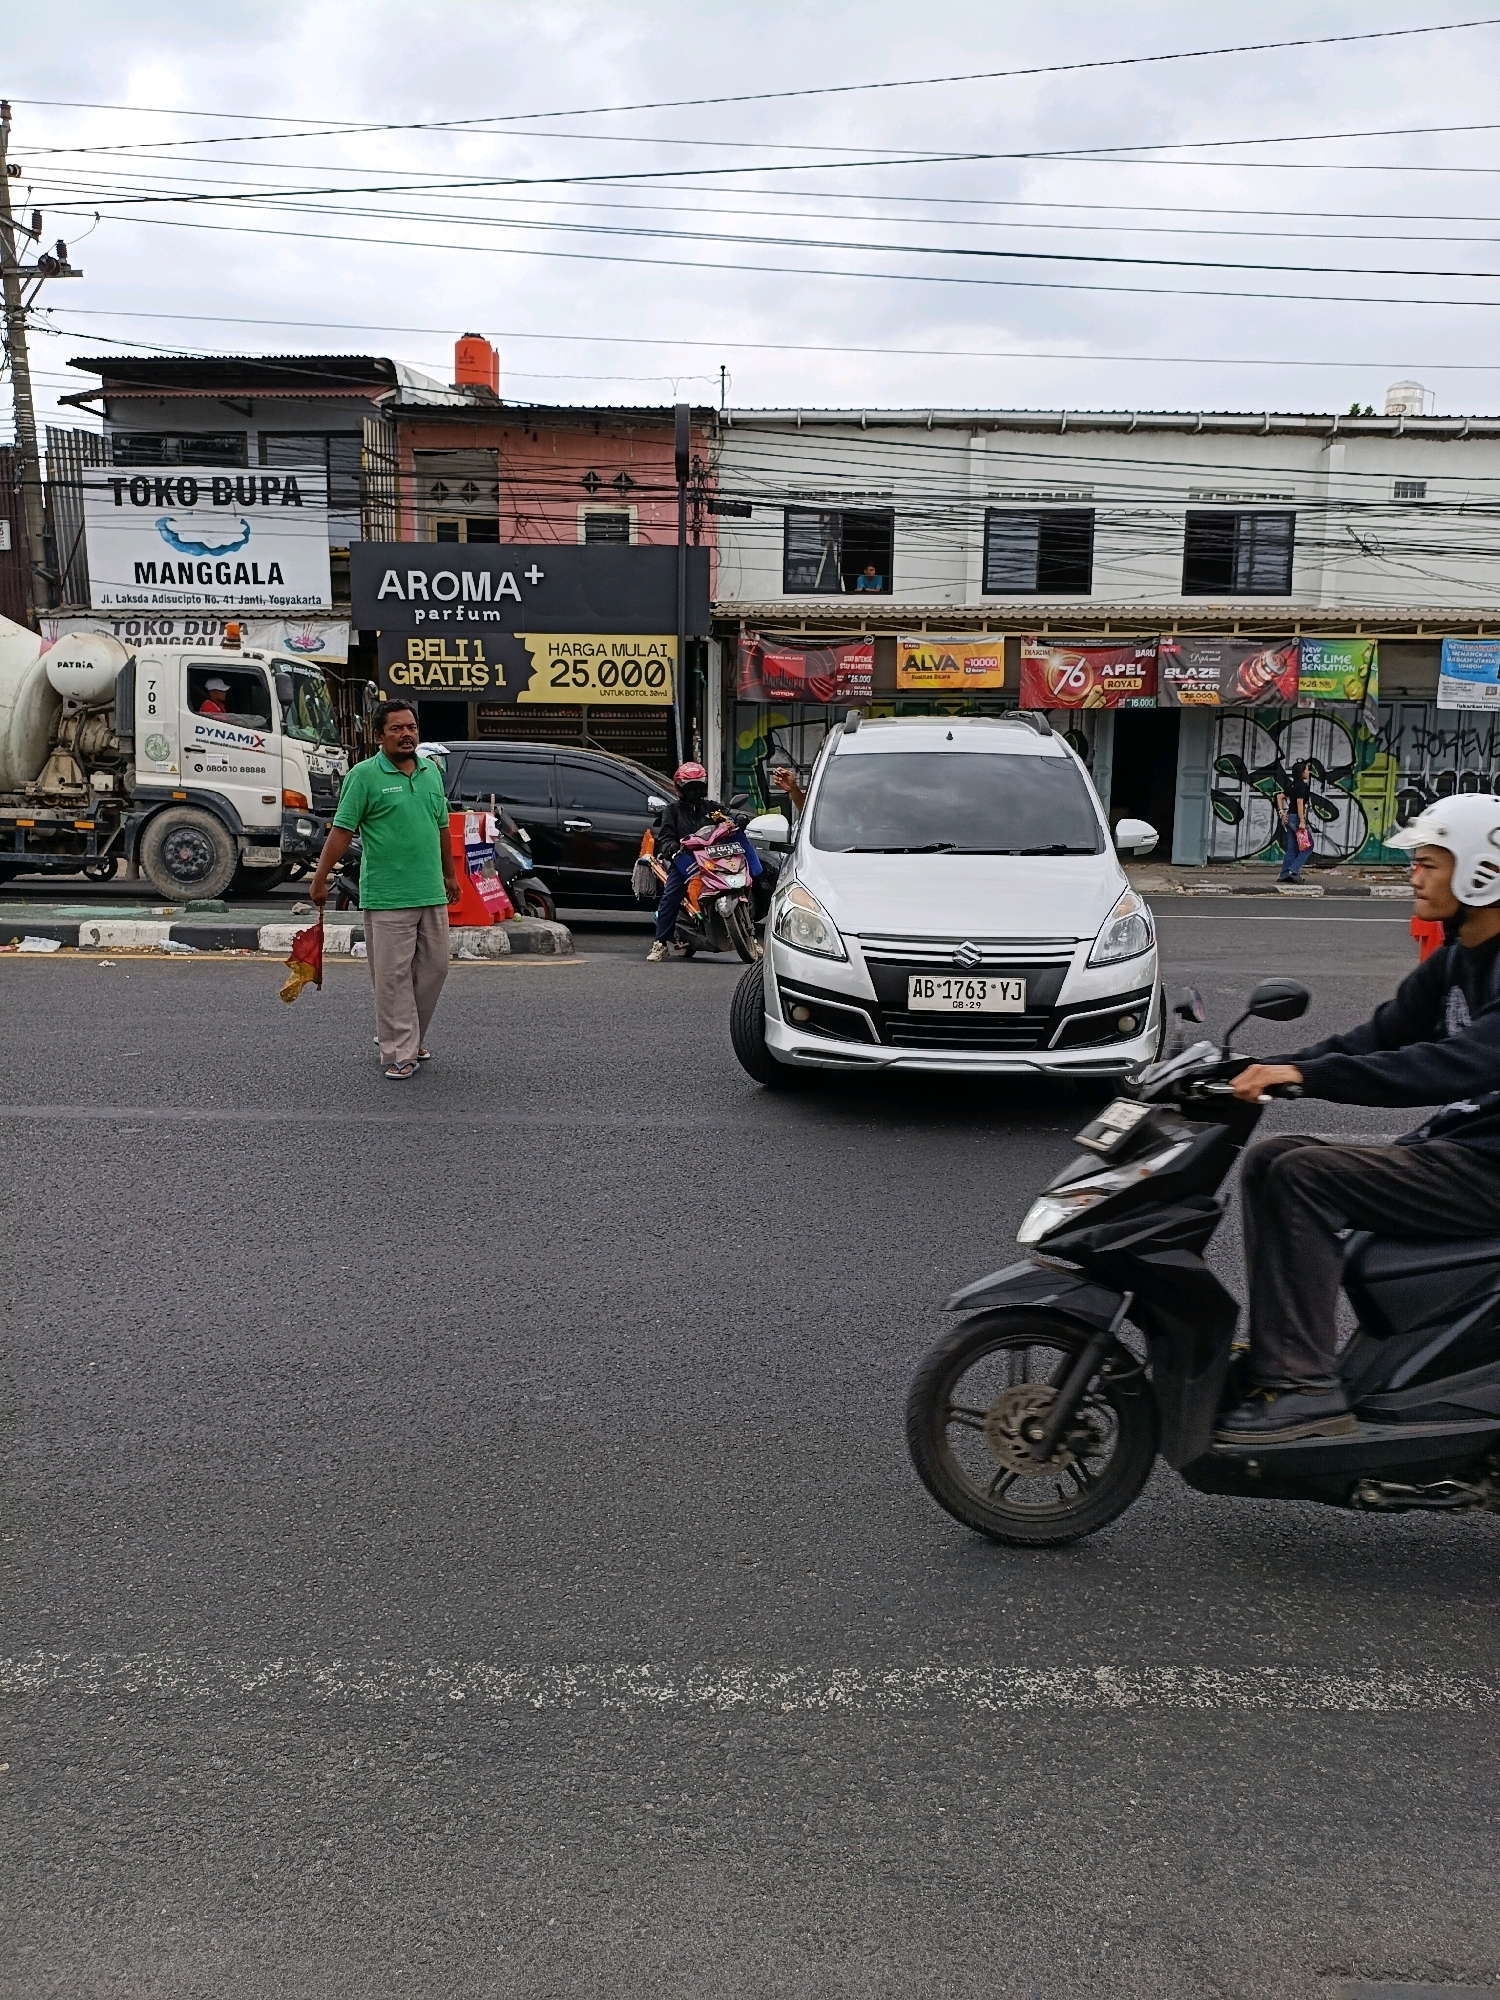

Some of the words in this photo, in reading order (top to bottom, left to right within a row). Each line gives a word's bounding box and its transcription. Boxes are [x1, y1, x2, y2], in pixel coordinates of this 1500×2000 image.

[107, 476, 198, 507] TOKO
[212, 475, 303, 507] DUPA
[134, 561, 285, 585] MANGGALA
[101, 594, 113, 605] Jl.
[116, 594, 149, 605] Laksda
[151, 594, 202, 606] Adisucipto
[204, 594, 220, 605] No.
[222, 594, 235, 605] 41
[268, 594, 322, 607] Yogyakarta
[414, 605, 501, 625] parfum
[110, 620, 174, 637] TOKO
[407, 638, 469, 662] BELI
[473, 639, 486, 662] 1
[548, 642, 608, 657] HARGA
[611, 643, 668, 658] MULAI
[1134, 648, 1156, 658] BARU
[1302, 646, 1323, 654] NEW
[902, 654, 960, 672] ALVA
[1301, 653, 1321, 663] ICE
[1323, 654, 1352, 665] LIME
[388, 662, 490, 686] GRATIS
[494, 663, 507, 686] 1
[550, 658, 666, 688] 25.000
[1101, 663, 1147, 676] APEL
[1163, 667, 1221, 679] BLAZE
[1301, 663, 1356, 673] SENSATION
[1053, 657, 1087, 696] 76
[1107, 679, 1140, 688] ROYAL
[599, 689, 624, 697] UNTUK
[624, 689, 648, 697] BOTOL
[1180, 683, 1220, 691] FILTER
[195, 725, 267, 748] DYNAMIX
[229, 765, 238, 773] 10
[912, 978, 935, 998] AB
[942, 979, 987, 1000] 1763
[1000, 981, 1022, 1001] YJ
